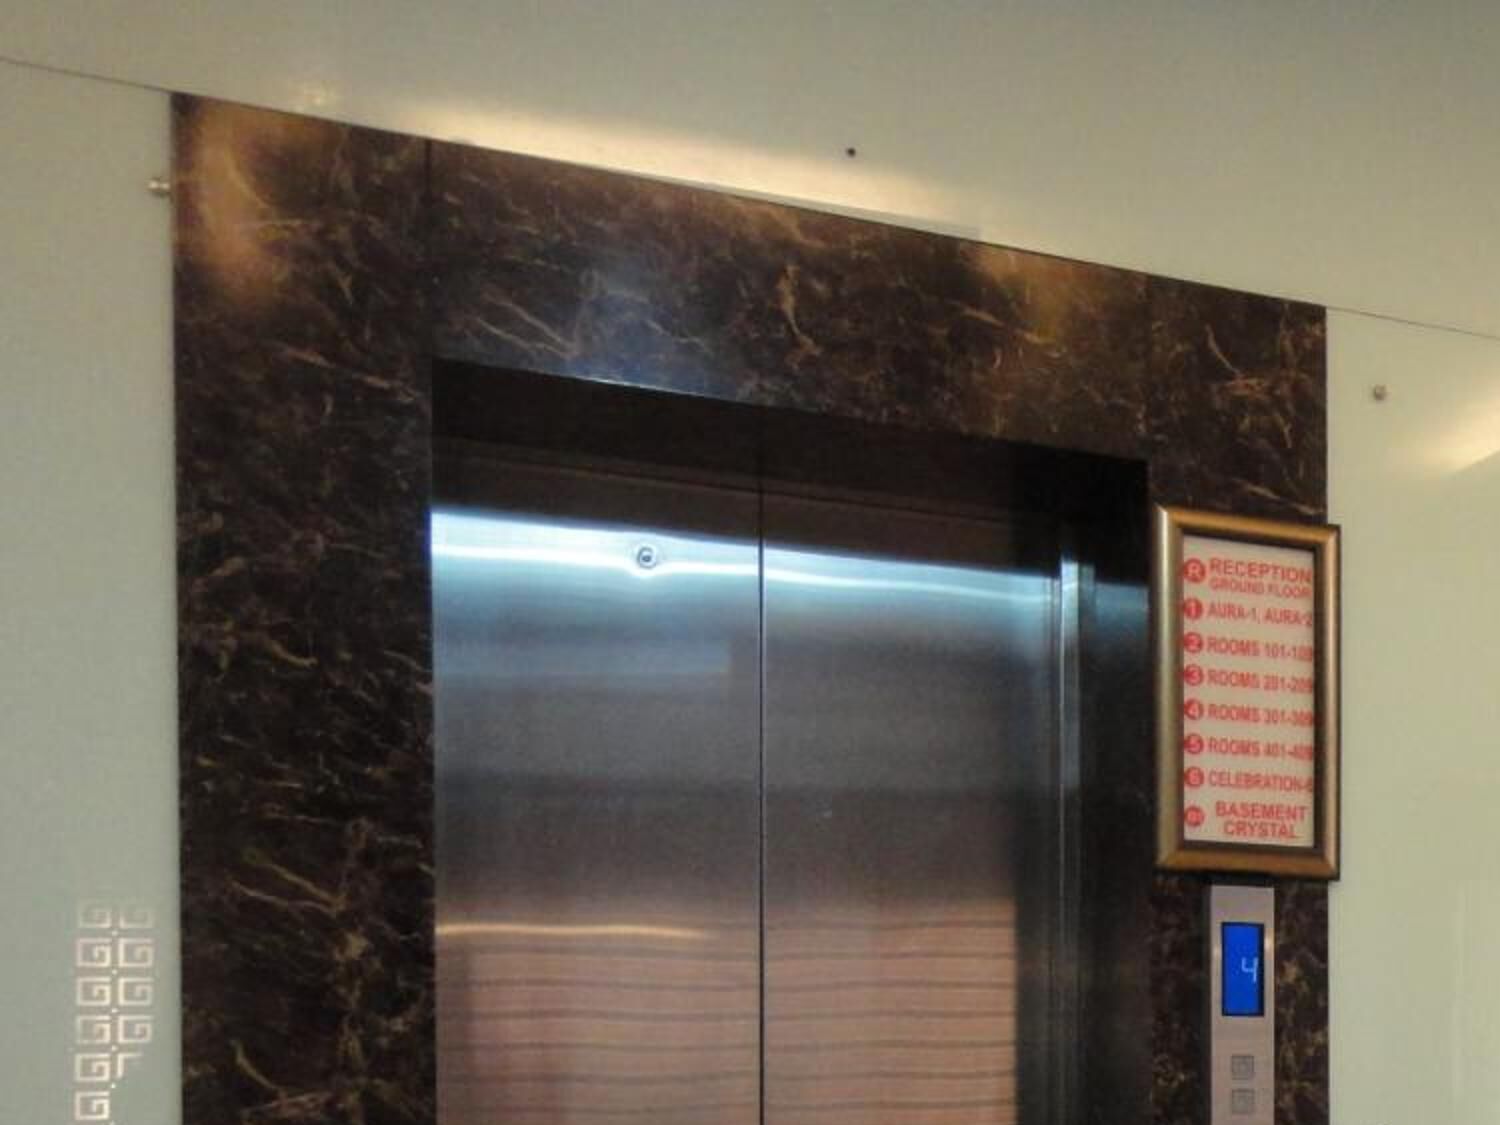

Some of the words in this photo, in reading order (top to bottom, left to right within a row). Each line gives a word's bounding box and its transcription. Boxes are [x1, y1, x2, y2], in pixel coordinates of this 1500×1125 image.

[1209, 558, 1312, 583] RECEPTION
[1209, 577, 1264, 595] GROUND
[1208, 637, 1259, 657] ROOMS
[1208, 669, 1259, 688] ROOMS
[1208, 704, 1260, 723] ROOMS
[1208, 738, 1260, 757] ROOMS
[1215, 801, 1308, 821] BASEMENT
[1223, 820, 1299, 839] CRYSTAL
[1240, 956, 1259, 984] 4
